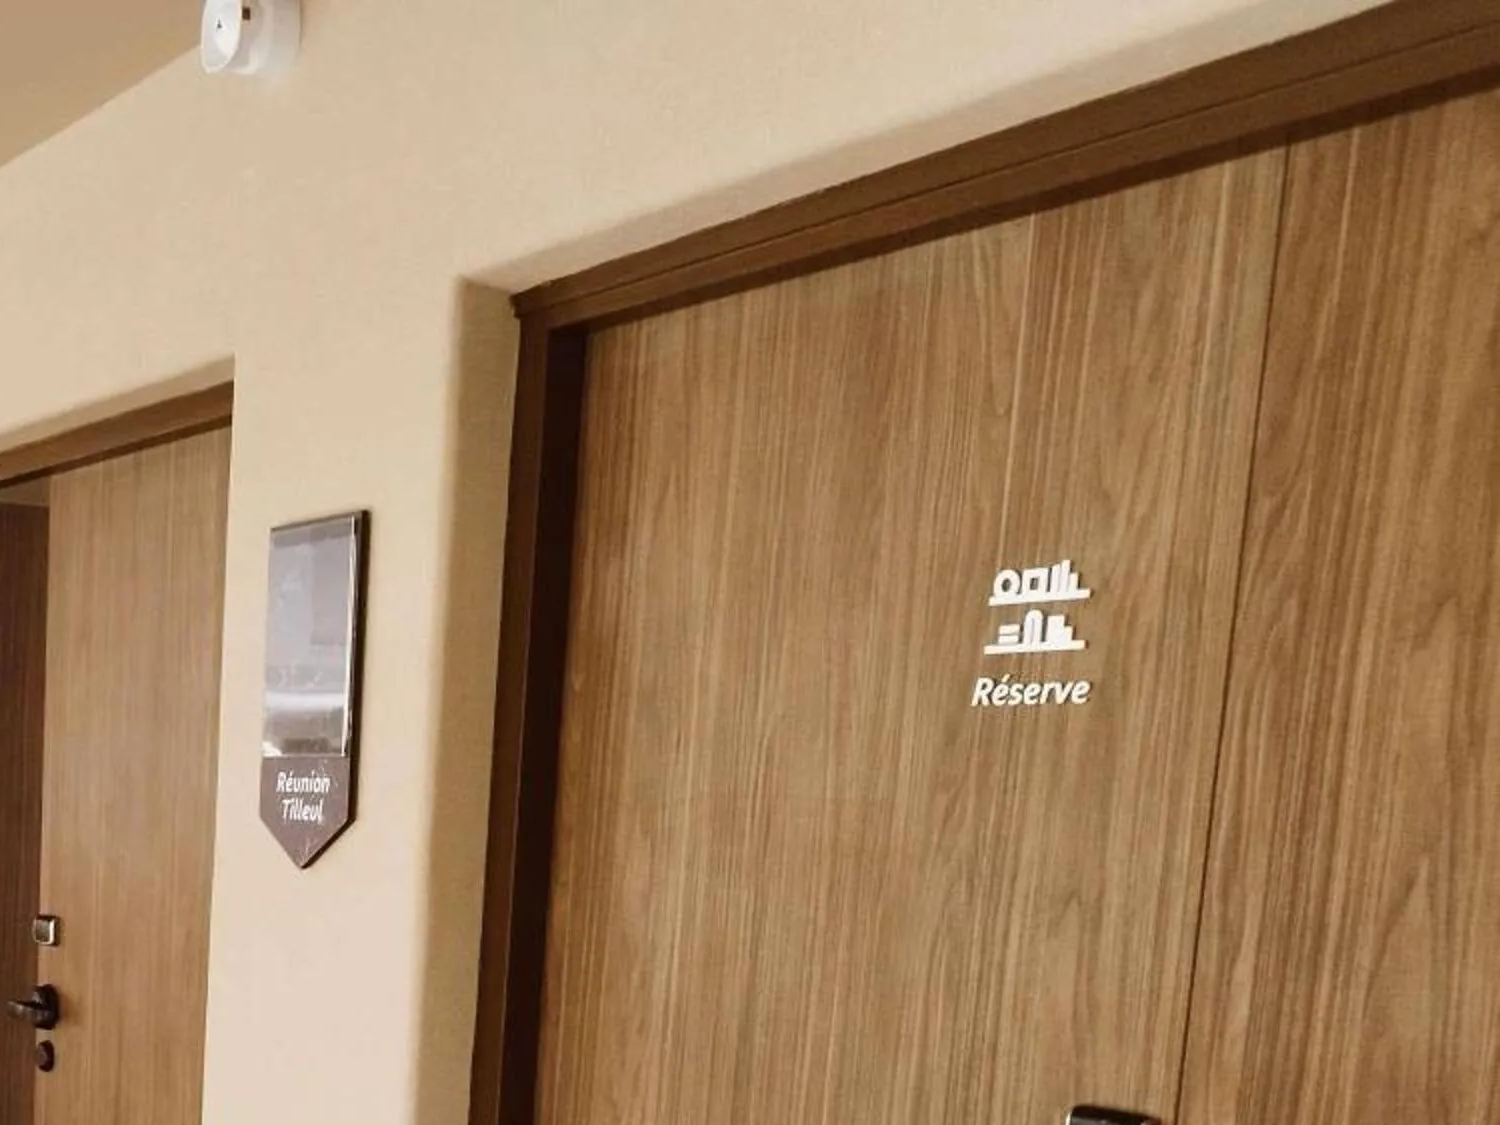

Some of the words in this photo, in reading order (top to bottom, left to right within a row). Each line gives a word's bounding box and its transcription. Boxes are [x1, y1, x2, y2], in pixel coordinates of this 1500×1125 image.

[970, 673, 1092, 707] Réserve
[275, 769, 331, 793] Réunion
[281, 797, 325, 824] Tilleul
